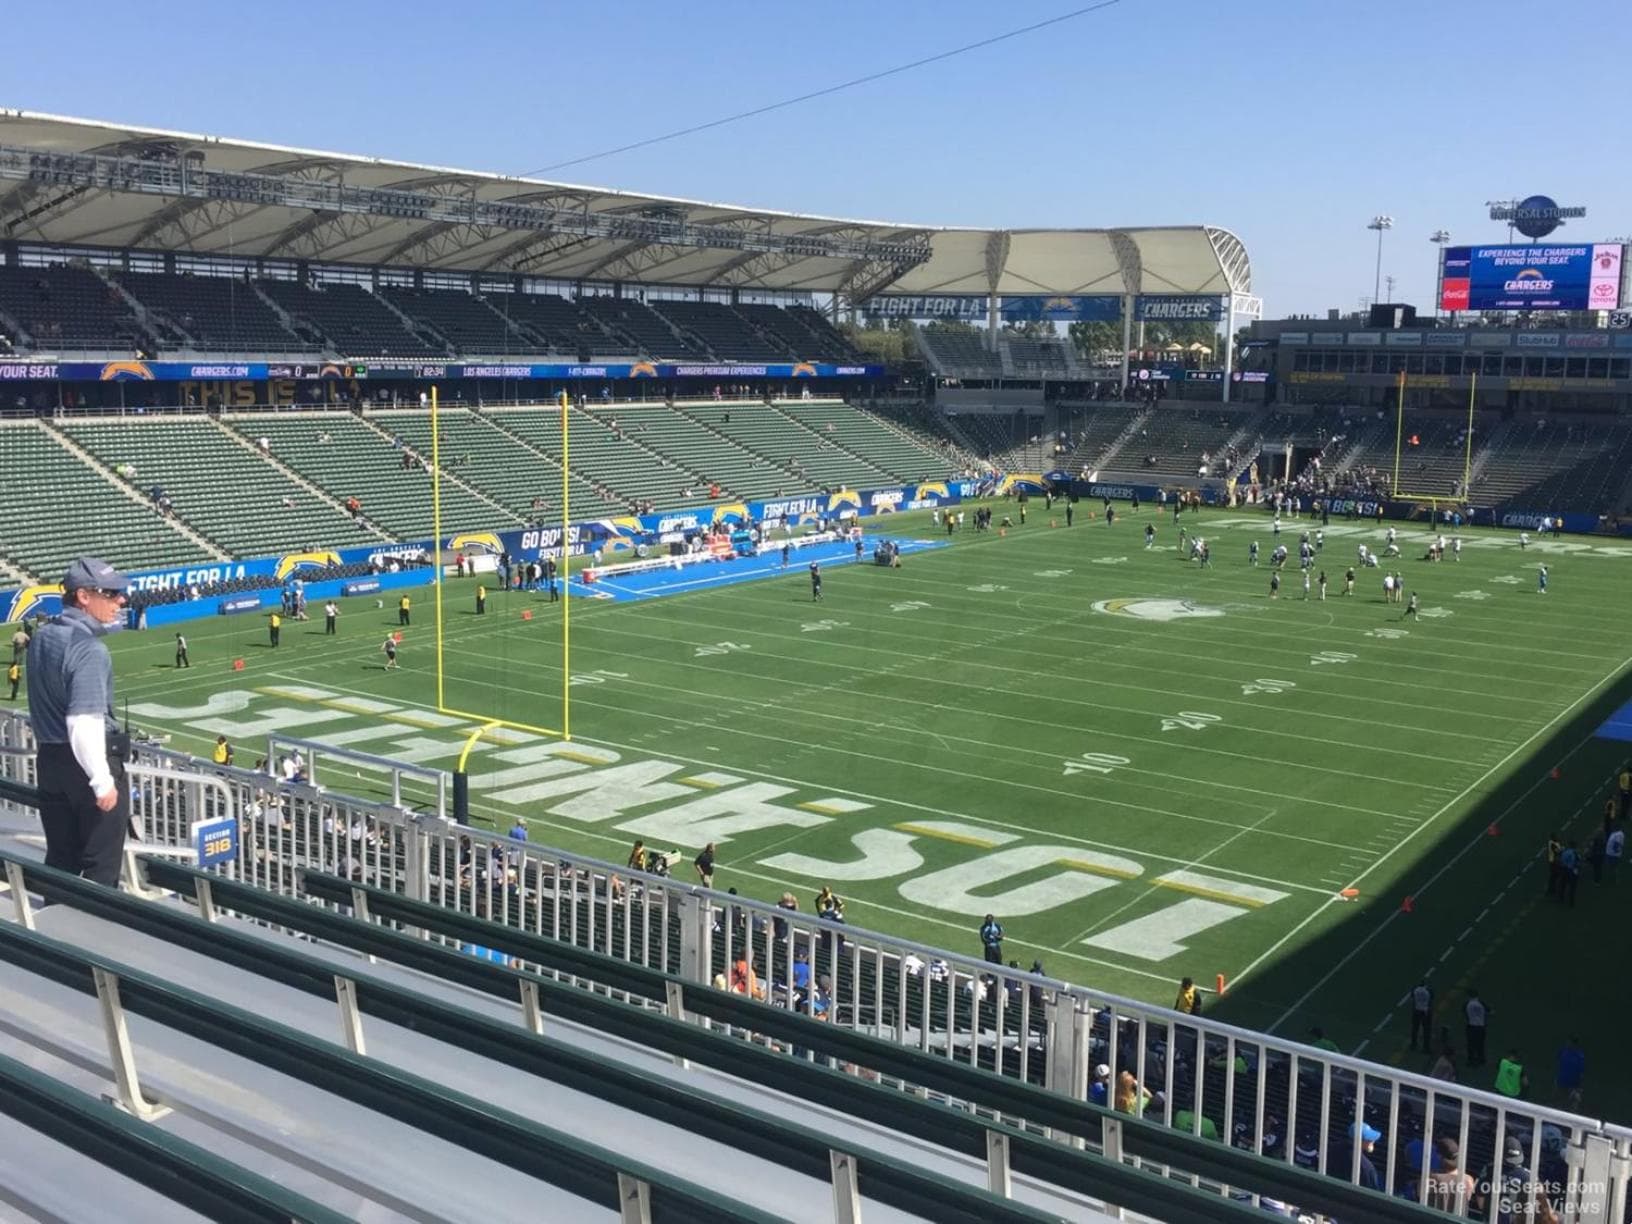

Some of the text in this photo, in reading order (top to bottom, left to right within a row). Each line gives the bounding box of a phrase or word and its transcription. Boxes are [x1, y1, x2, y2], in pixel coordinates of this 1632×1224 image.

[1478, 249, 1526, 258] EXPERIENCE
[1544, 248, 1587, 256] CHARGERS
[1504, 280, 1554, 291] CHARGERS
[869, 297, 980, 315] FIGHT FOR LA
[1143, 303, 1212, 318] CHARGERS
[28, 366, 59, 378] SEAT.
[191, 366, 248, 377] CHARGERS.COM
[522, 526, 580, 549] GO BOS!
[1161, 711, 1222, 730] 20
[1063, 753, 1130, 773] 10
[204, 838, 231, 857] 318
